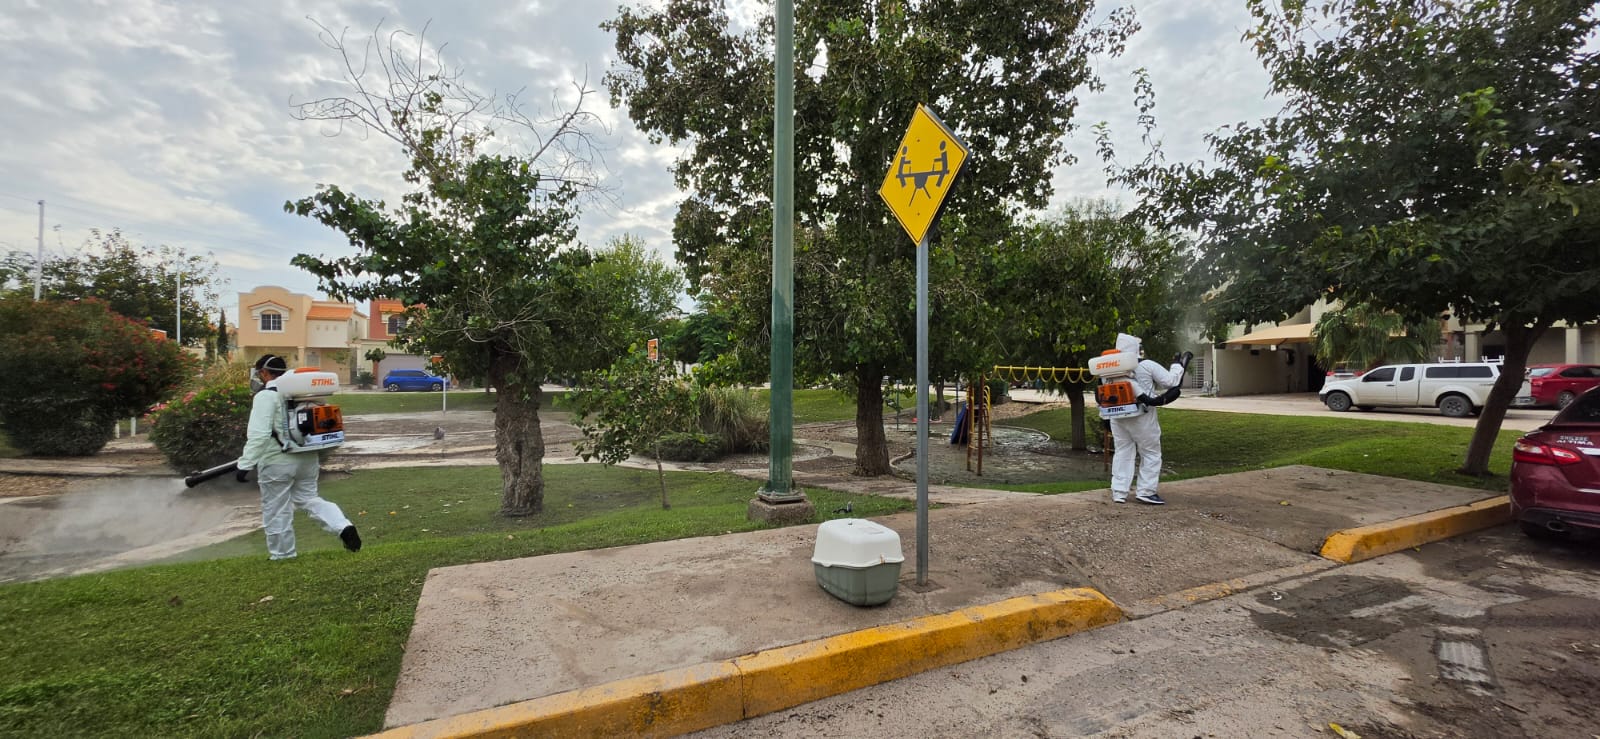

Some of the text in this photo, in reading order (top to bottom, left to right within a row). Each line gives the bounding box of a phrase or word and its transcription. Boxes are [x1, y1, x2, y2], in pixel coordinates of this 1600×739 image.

[1096, 360, 1120, 369] STIHL
[311, 378, 336, 386] STIHL
[322, 433, 340, 441] STIHL
